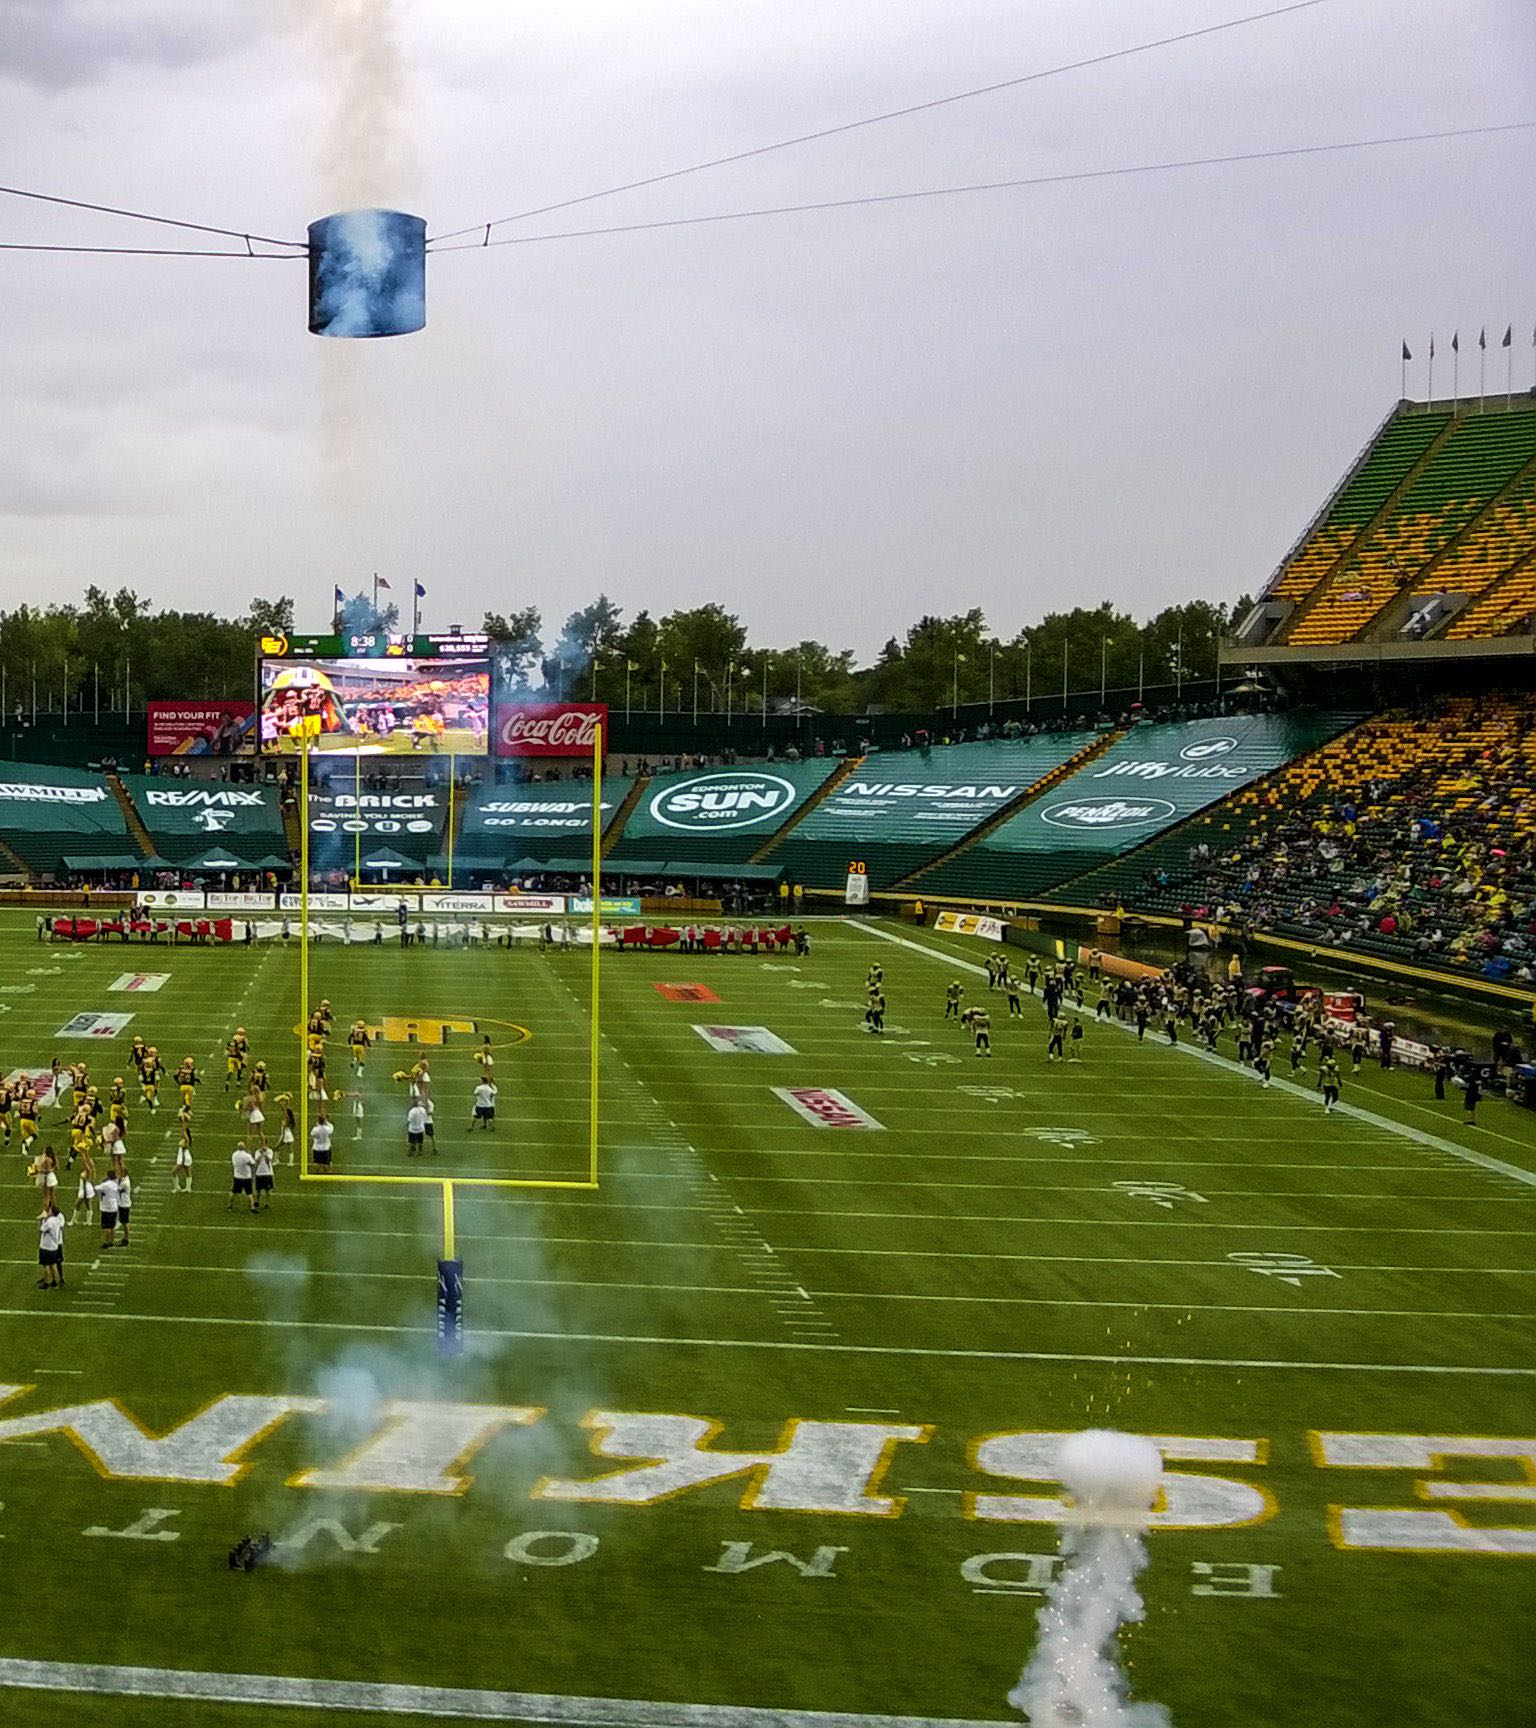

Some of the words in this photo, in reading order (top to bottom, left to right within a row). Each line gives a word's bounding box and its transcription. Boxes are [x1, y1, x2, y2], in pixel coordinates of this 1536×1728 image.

[350, 636, 375, 647] 8:38
[153, 711, 177, 720] FIND
[177, 711, 204, 720] YOUR
[205, 711, 221, 720] FIT
[1173, 763, 1248, 779] lube
[691, 783, 766, 793] EDMONTON
[844, 782, 1017, 798] NISSAN
[145, 789, 267, 806] RE/MAX
[334, 794, 436, 808] BRICK
[667, 790, 781, 812] SUN
[479, 802, 613, 813] SUBWAY
[692, 809, 739, 819] .com
[483, 818, 516, 826] GO
[849, 861, 865, 874] 20
[431, 896, 487, 910] VITERRA
